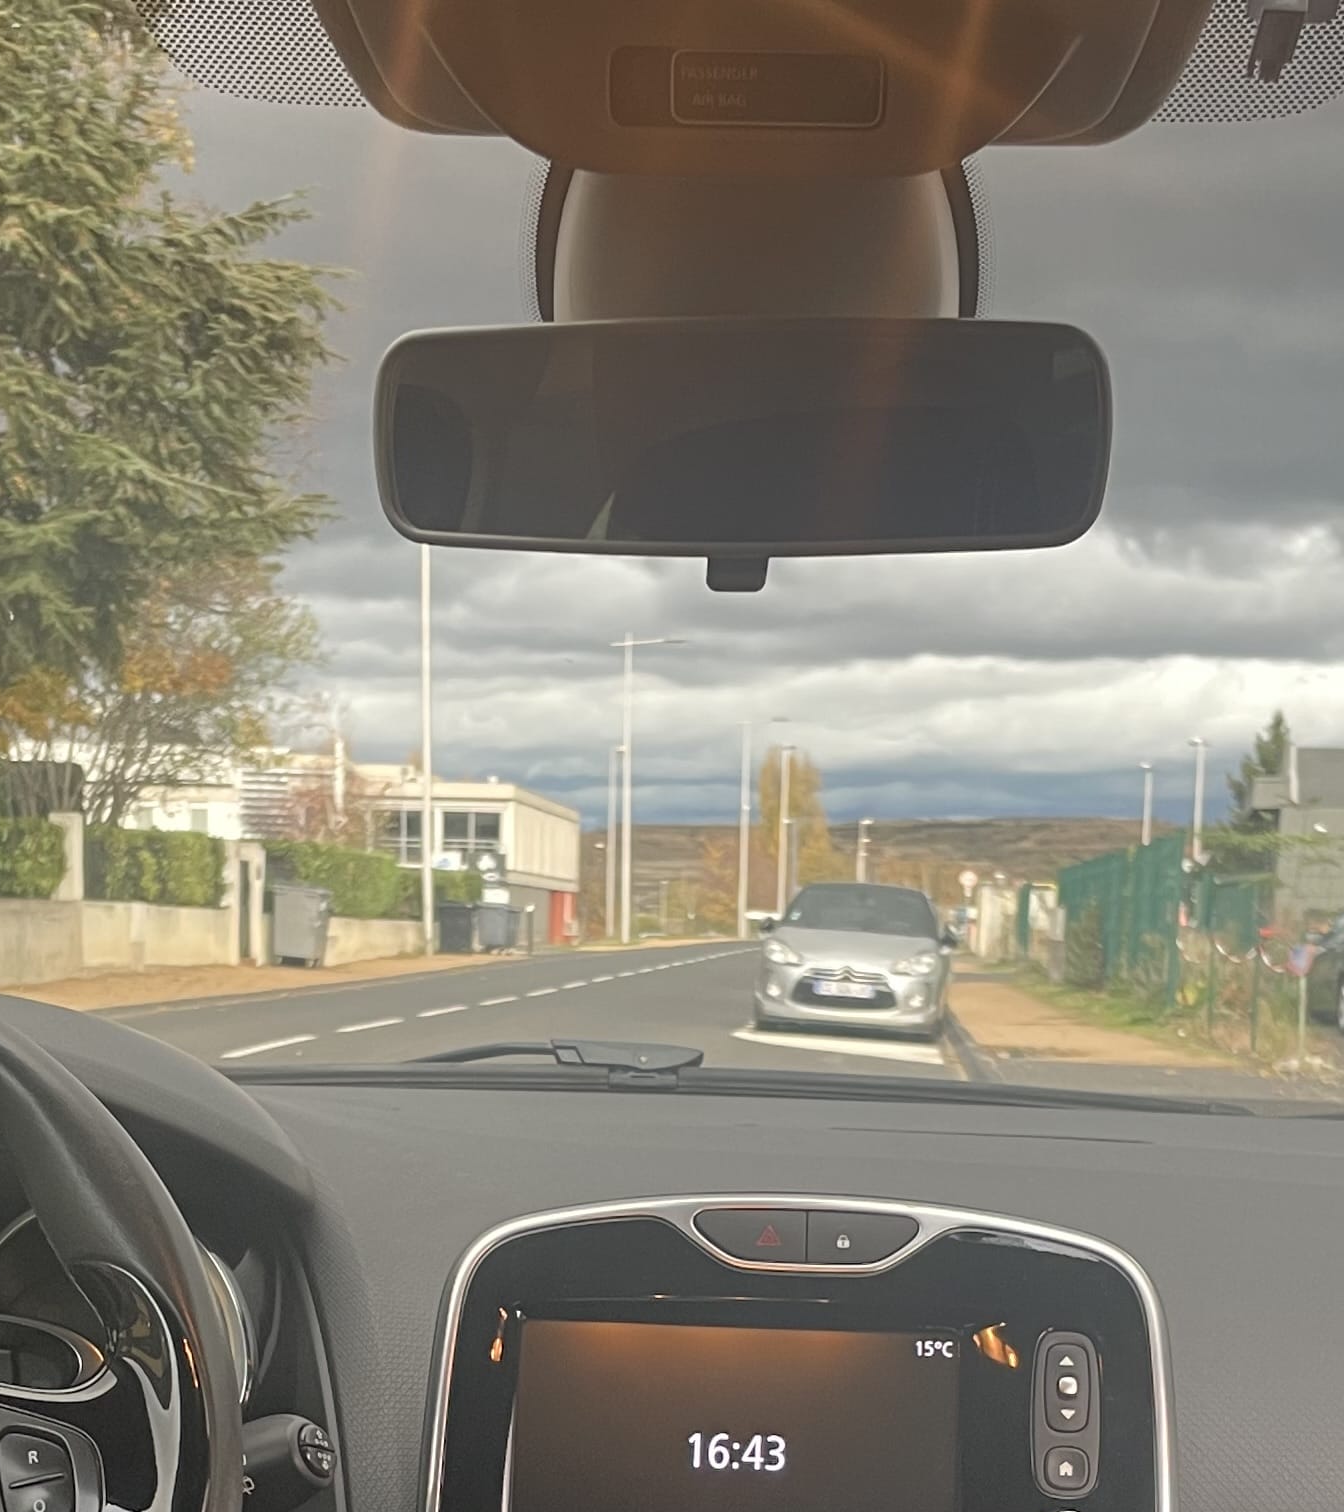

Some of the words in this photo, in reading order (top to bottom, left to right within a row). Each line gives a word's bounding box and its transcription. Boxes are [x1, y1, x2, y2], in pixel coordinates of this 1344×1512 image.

[915, 1340, 954, 1358] 15°C
[27, 1450, 39, 1464] R
[688, 1432, 786, 1472] 16:43
